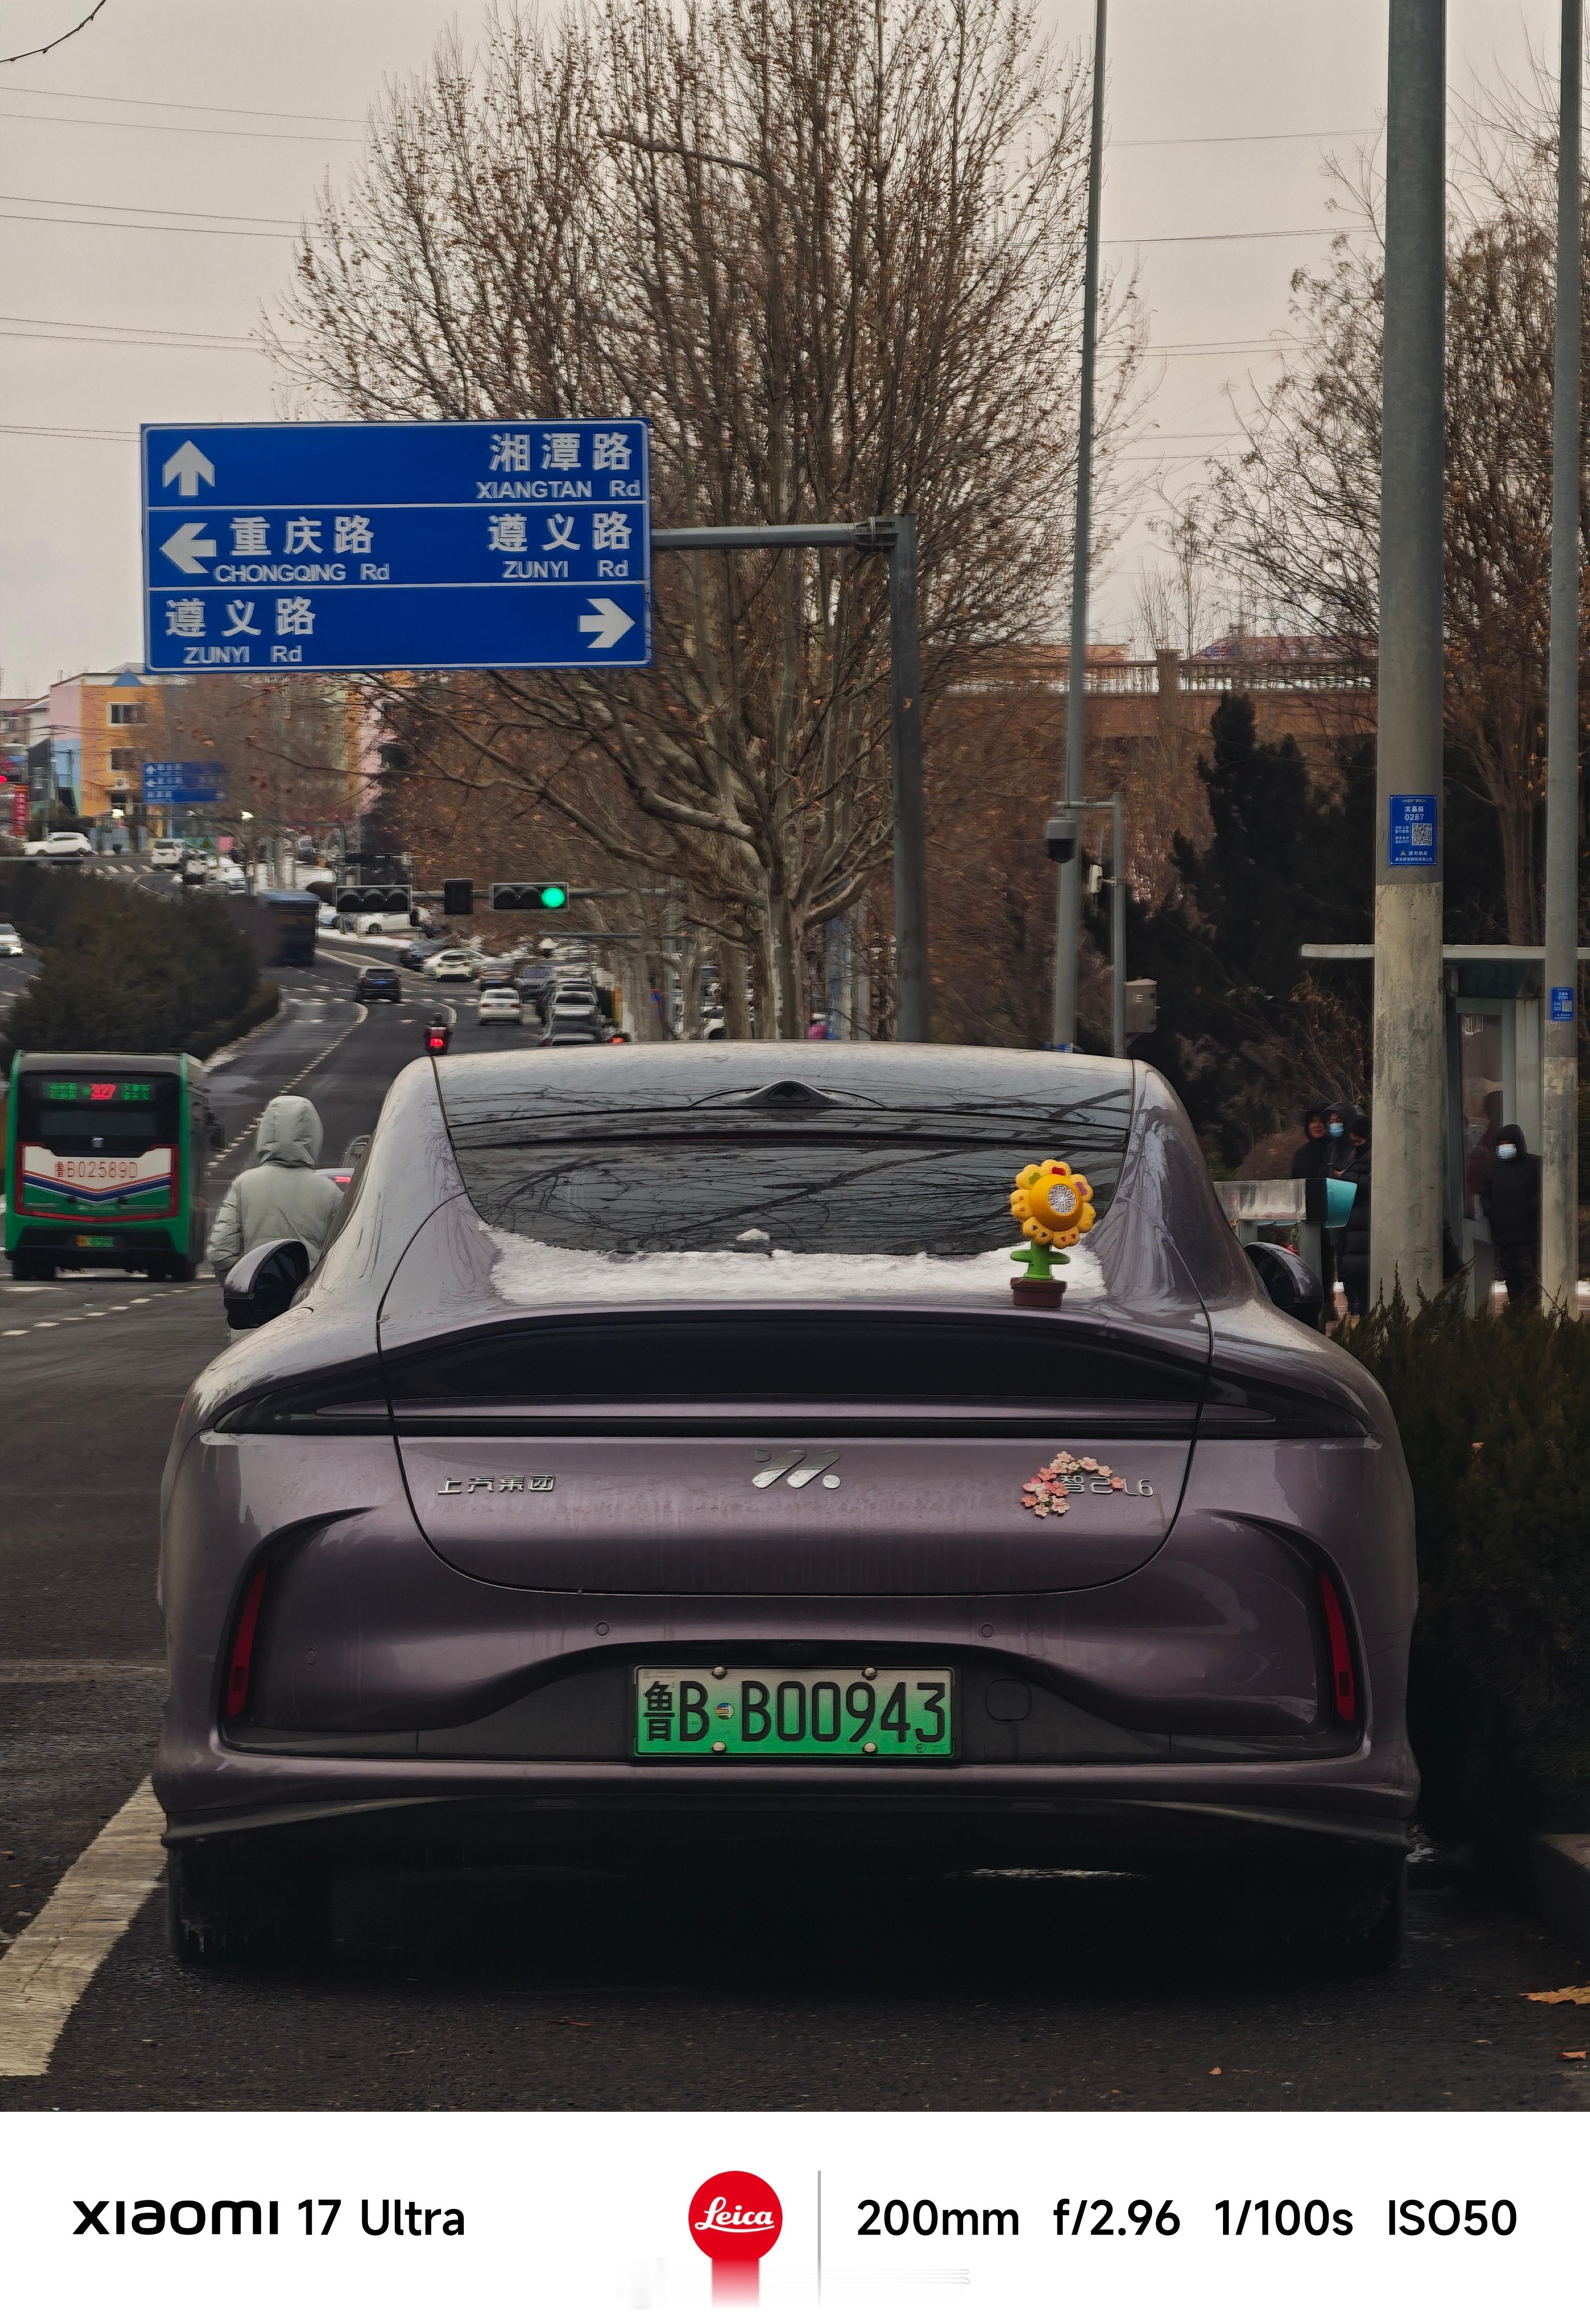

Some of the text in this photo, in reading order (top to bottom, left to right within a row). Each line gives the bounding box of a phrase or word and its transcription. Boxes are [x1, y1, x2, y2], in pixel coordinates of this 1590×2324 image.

[489, 432, 631, 473] 湘潭路
[475, 479, 640, 499] XIANGTAN Rd
[230, 514, 374, 556] 重庆路
[488, 511, 632, 553] 遵义路
[214, 563, 390, 583] CHONGQING Rd
[503, 559, 629, 579] ZUNYI Rd
[165, 596, 316, 638] 遵义路
[184, 644, 303, 665] ZUNYI Rd
[437, 1474, 555, 1495] 上汽集团
